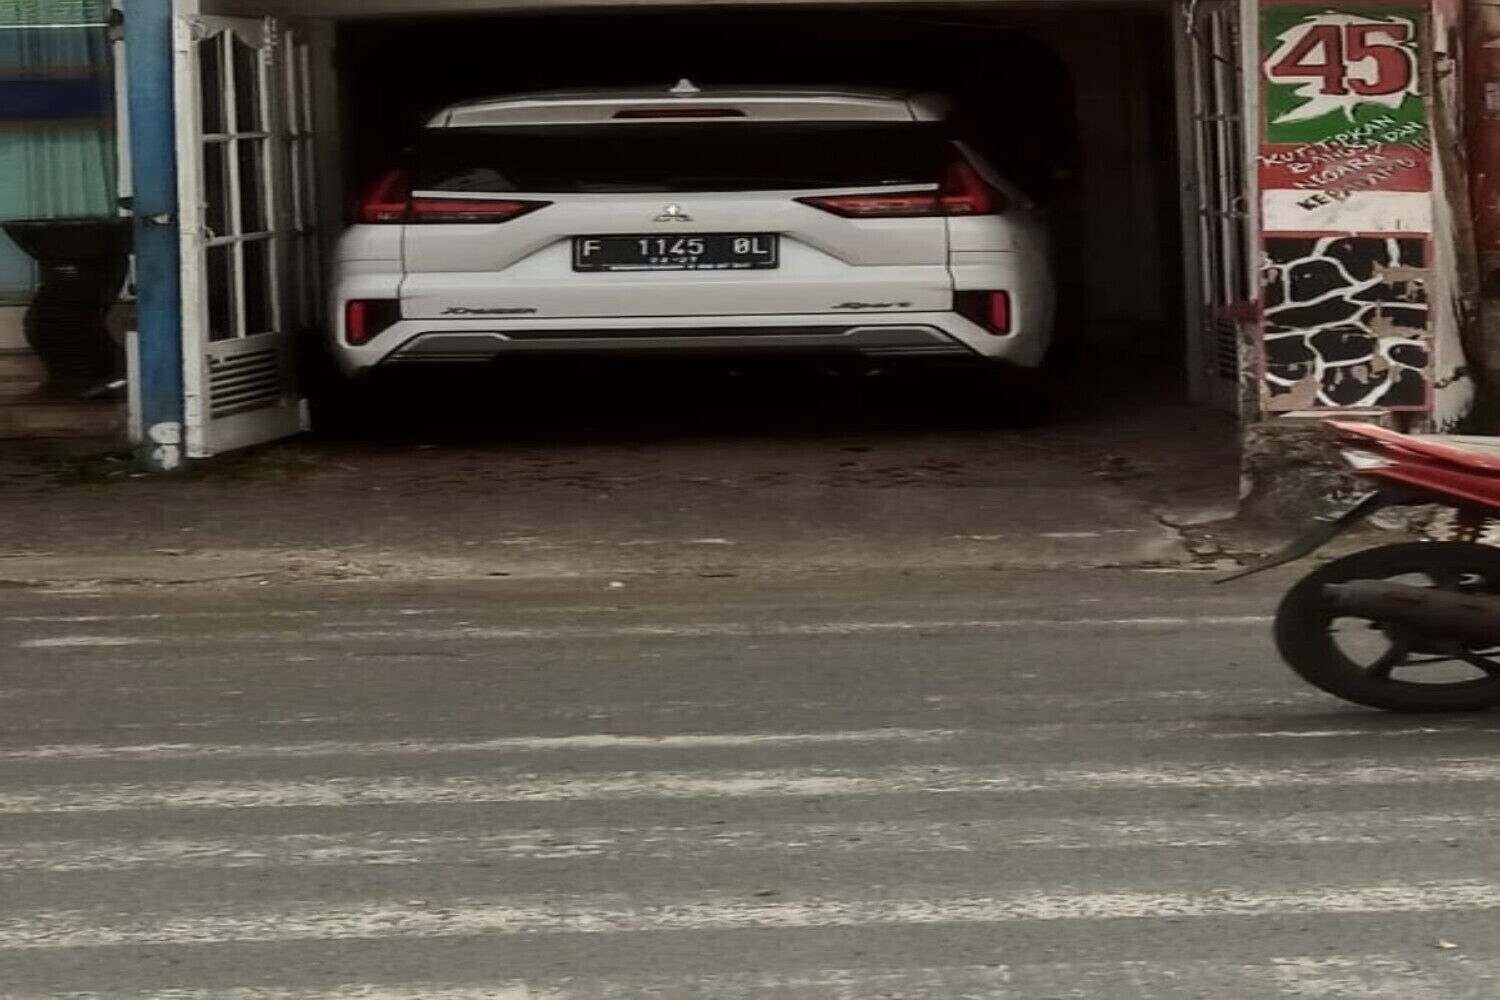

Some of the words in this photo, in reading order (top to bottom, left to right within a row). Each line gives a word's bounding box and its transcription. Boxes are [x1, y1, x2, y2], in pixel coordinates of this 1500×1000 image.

[1270, 23, 1412, 97] 45
[583, 239, 601, 257] F
[638, 238, 705, 257] 1145
